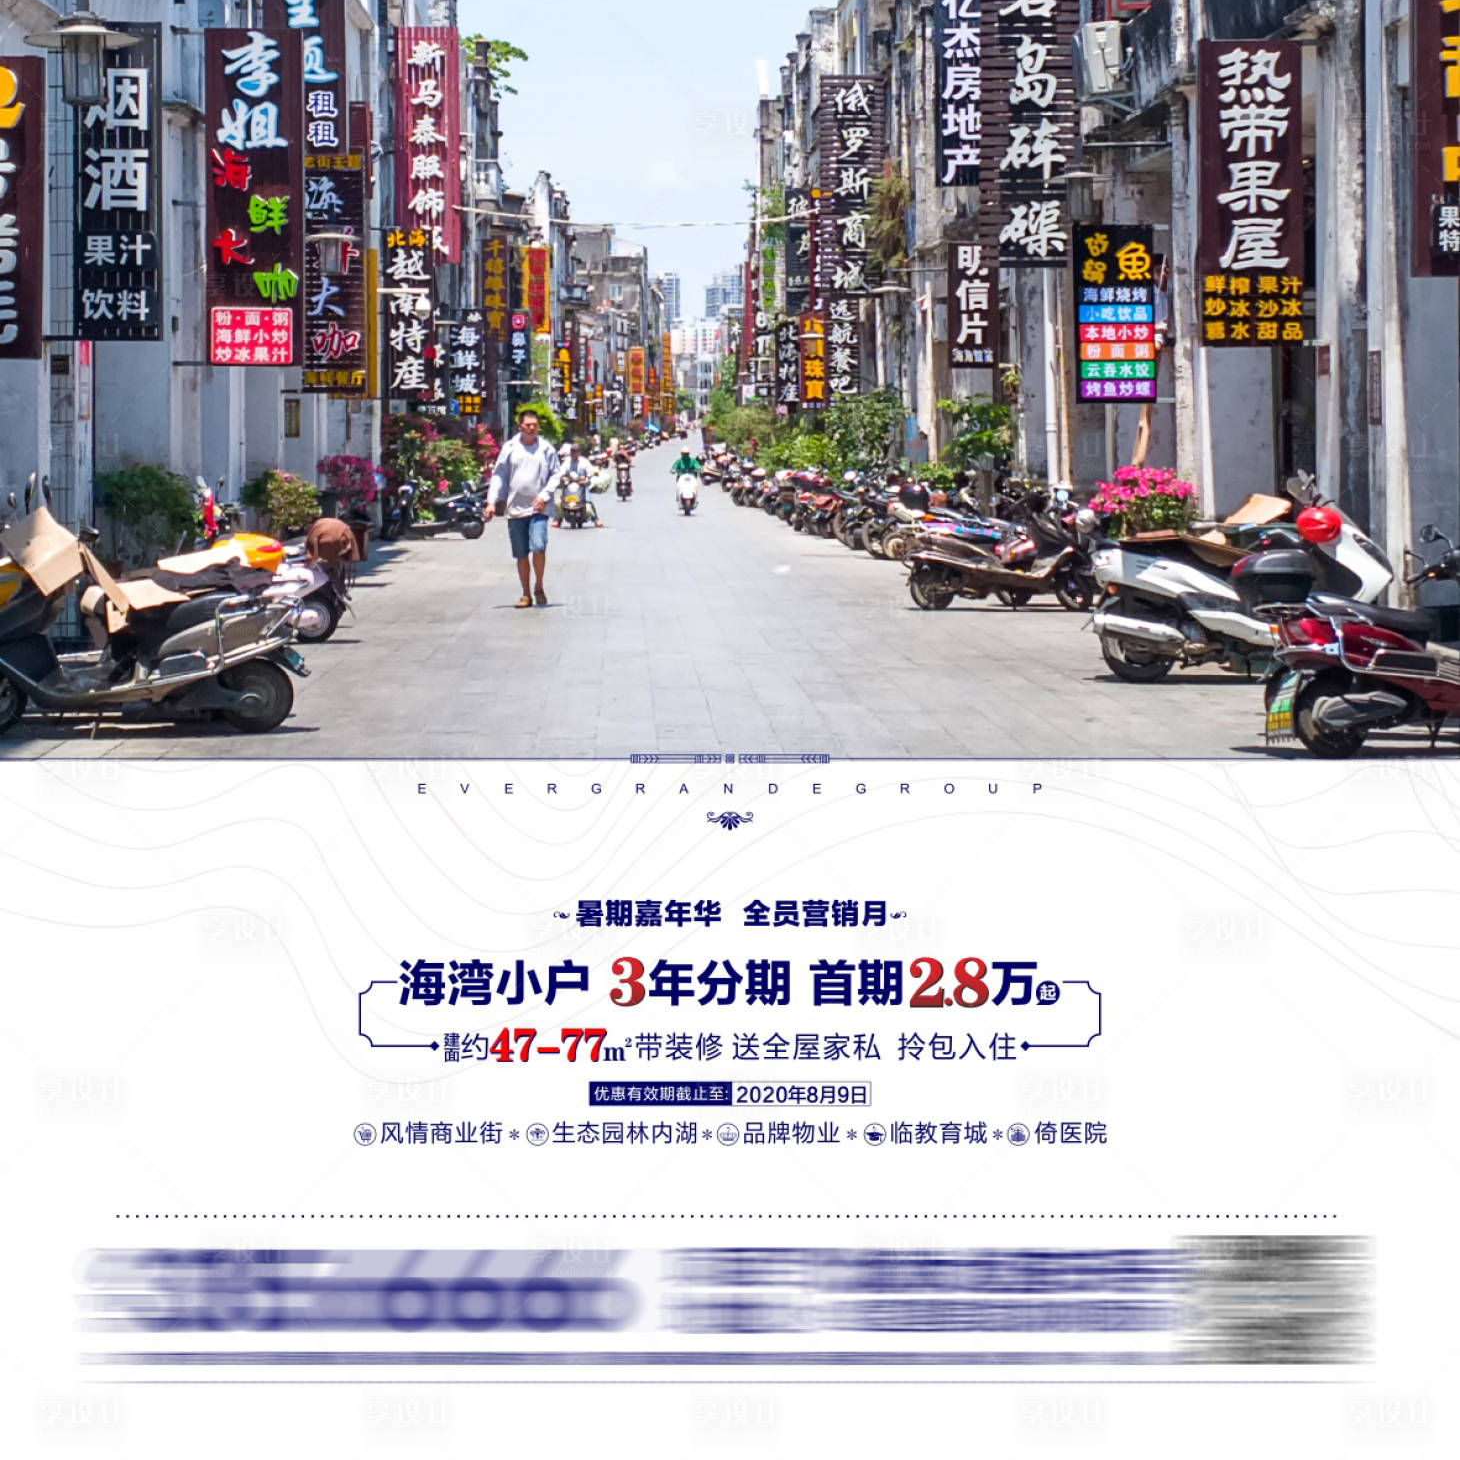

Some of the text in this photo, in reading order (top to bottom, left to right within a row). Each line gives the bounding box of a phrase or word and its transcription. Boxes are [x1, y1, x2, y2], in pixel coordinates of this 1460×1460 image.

[217, 31, 288, 150] 李姐
[83, 68, 149, 212] 烟酒
[1217, 47, 1292, 270] 热带果屋
[833, 83, 875, 290] 俄罗斯商城
[84, 234, 151, 266] 果汁
[82, 289, 149, 322] 饮料
[956, 245, 990, 344] 明信片
[1086, 306, 1147, 322] 小吃饮品
[215, 328, 289, 344] 海鲜小炒
[1085, 323, 1149, 341] 本地小炒
[215, 347, 288, 362] 炒冰果汁
[1087, 361, 1149, 378] 云吞水饺
[575, 900, 886, 928] 暑期嘉年华 全员营销月
[399, 959, 589, 1007] 海湾小户
[609, 957, 790, 1007] 3年分期
[732, 1031, 881, 1061] 送全屋家私
[898, 1031, 1016, 1061] 拎包入住
[736, 1085, 866, 1104] 2020年8月9日
[381, 1120, 1108, 1144] 风情商业街 生态园林内湖 品牌物业 临教育城 倚医院
